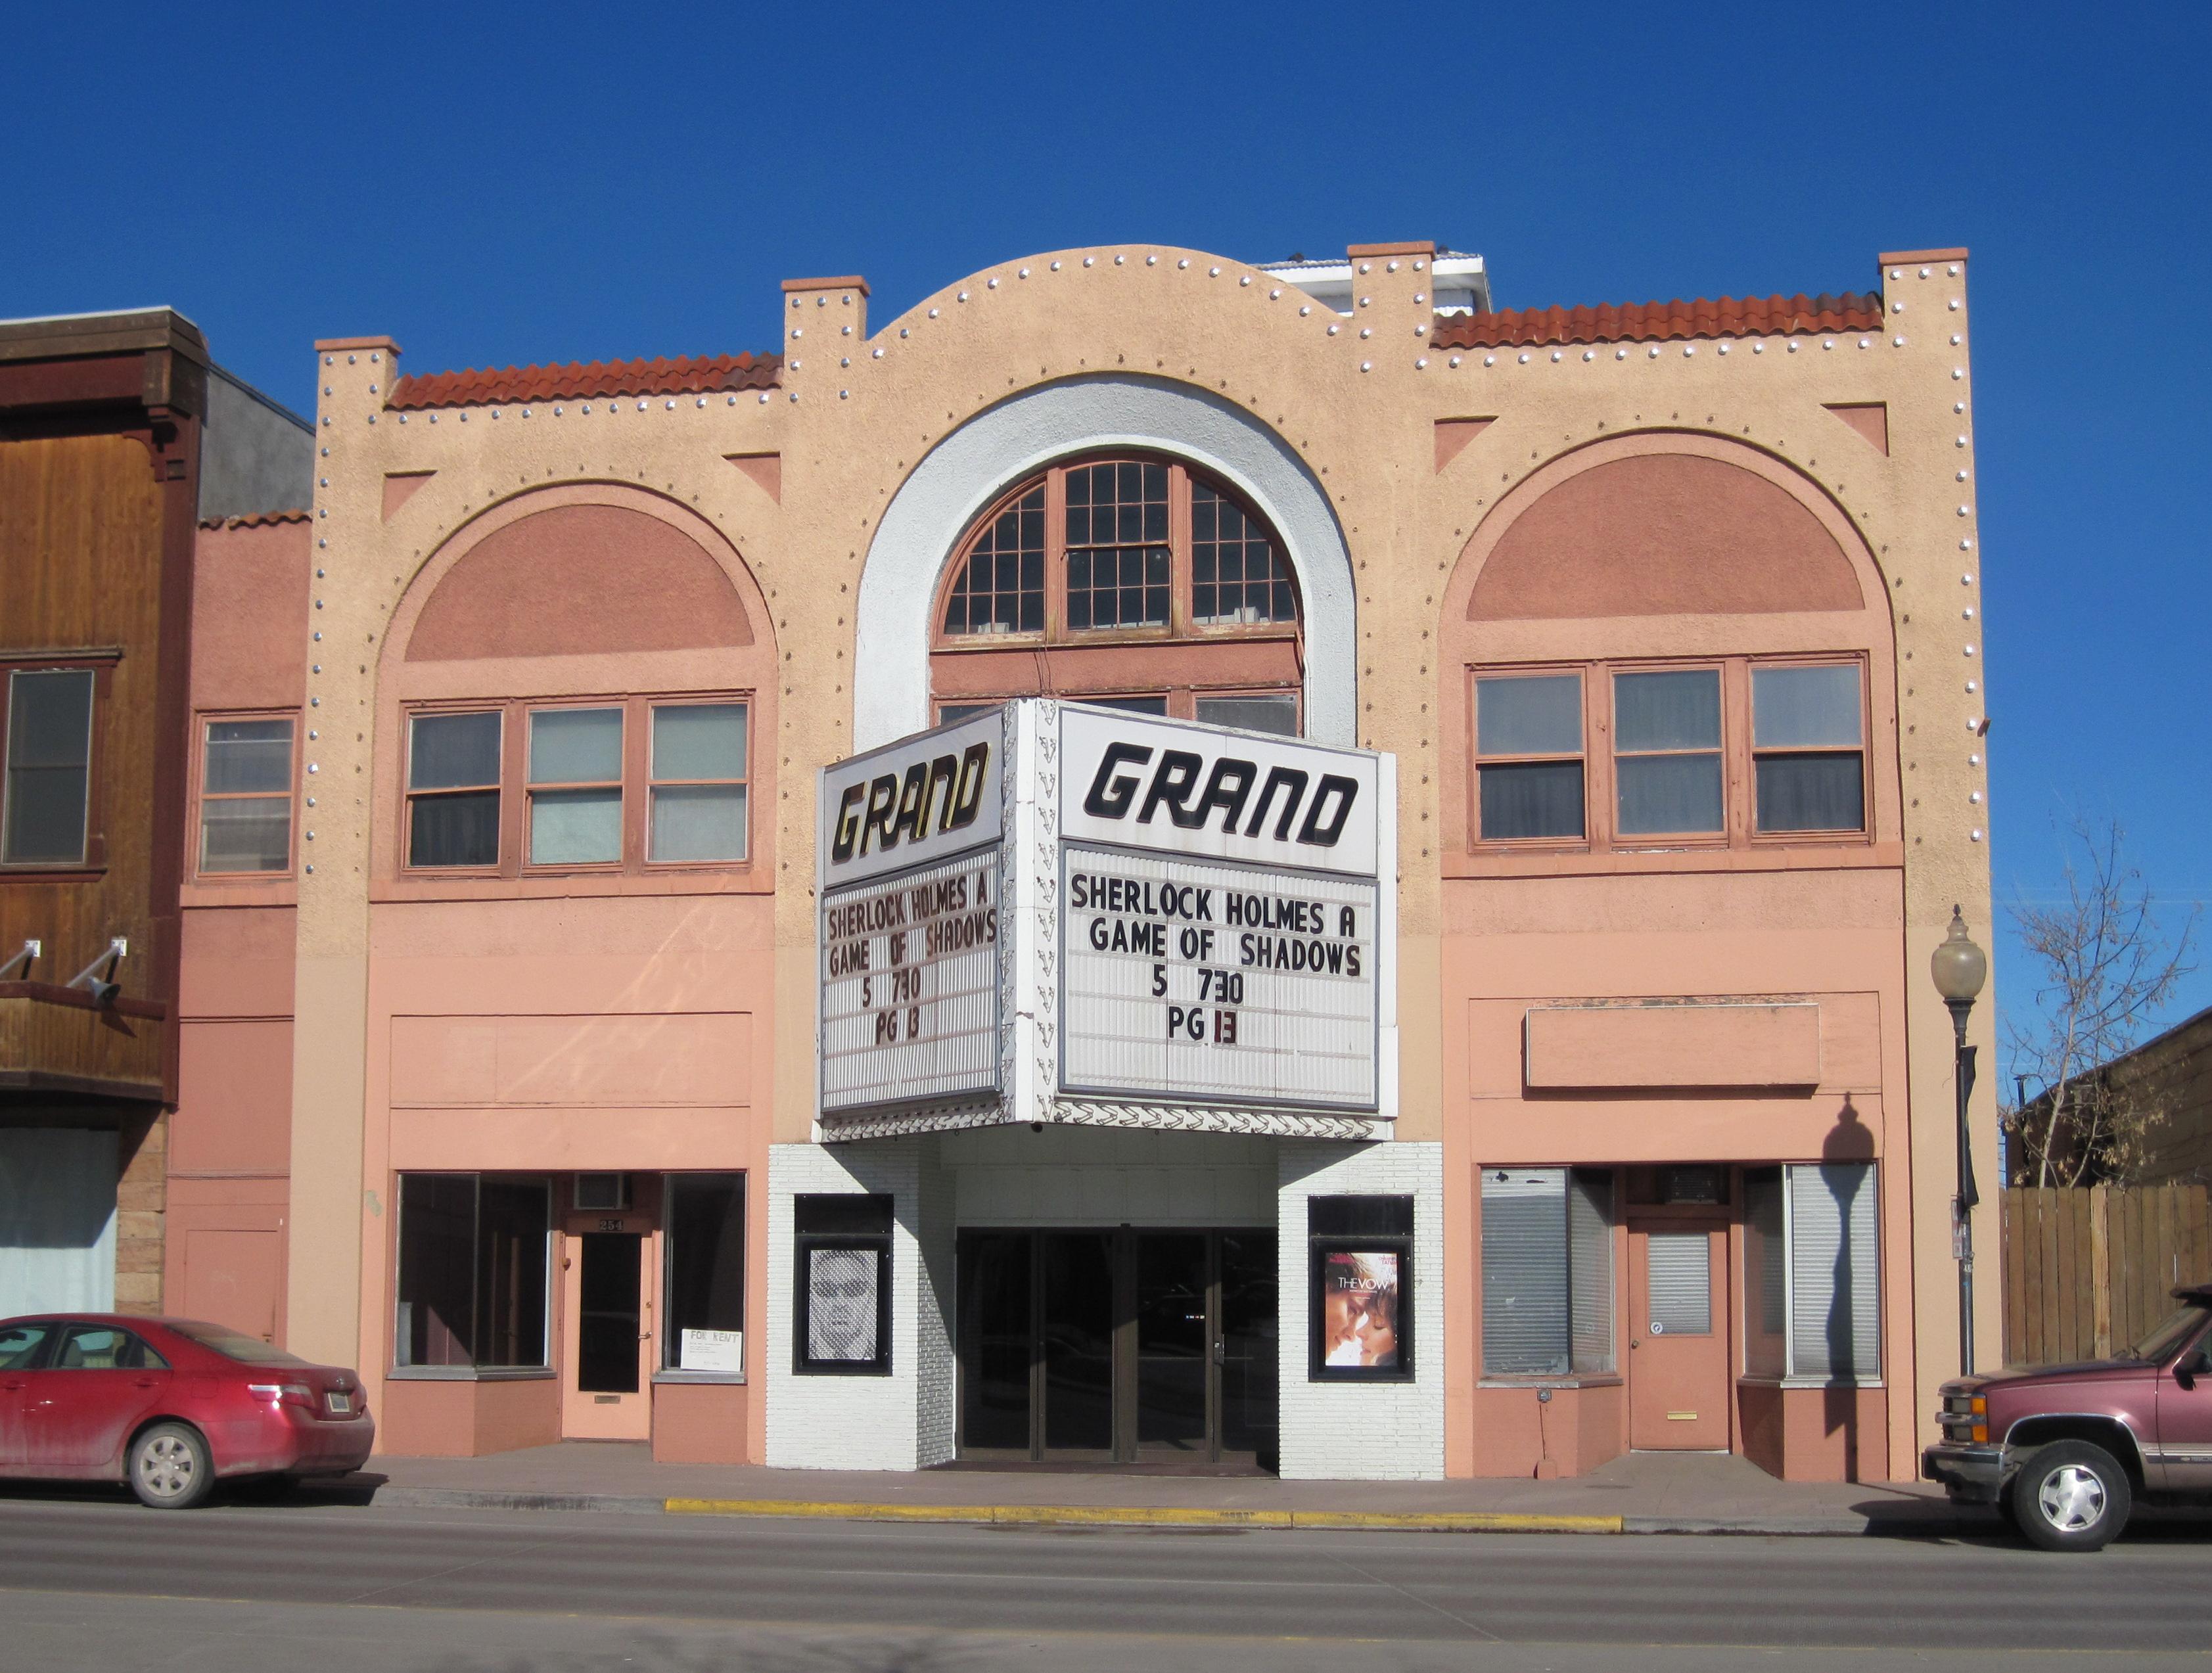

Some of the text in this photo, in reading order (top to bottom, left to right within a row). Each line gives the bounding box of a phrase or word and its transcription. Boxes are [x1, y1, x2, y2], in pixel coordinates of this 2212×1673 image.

[831, 741, 990, 866] GRAND
[1082, 741, 1359, 847] GRAND
[828, 871, 988, 941] SHERLOCK HOLMES A
[1071, 873, 1356, 938] SHERLOCK HOLMES A
[829, 908, 998, 978] GAME OF SHADOWS
[1090, 917, 1361, 977] GAME OF SHADOWS
[862, 967, 921, 1008] 5 730
[1151, 963, 1244, 1005] 5 730
[875, 1006, 920, 1045] PG 13
[1168, 1005, 1237, 1044] PG 13
[599, 1220, 623, 1231] 254
[1337, 1277, 1389, 1291] THE VOW
[690, 1330, 740, 1343] FOR RENT
